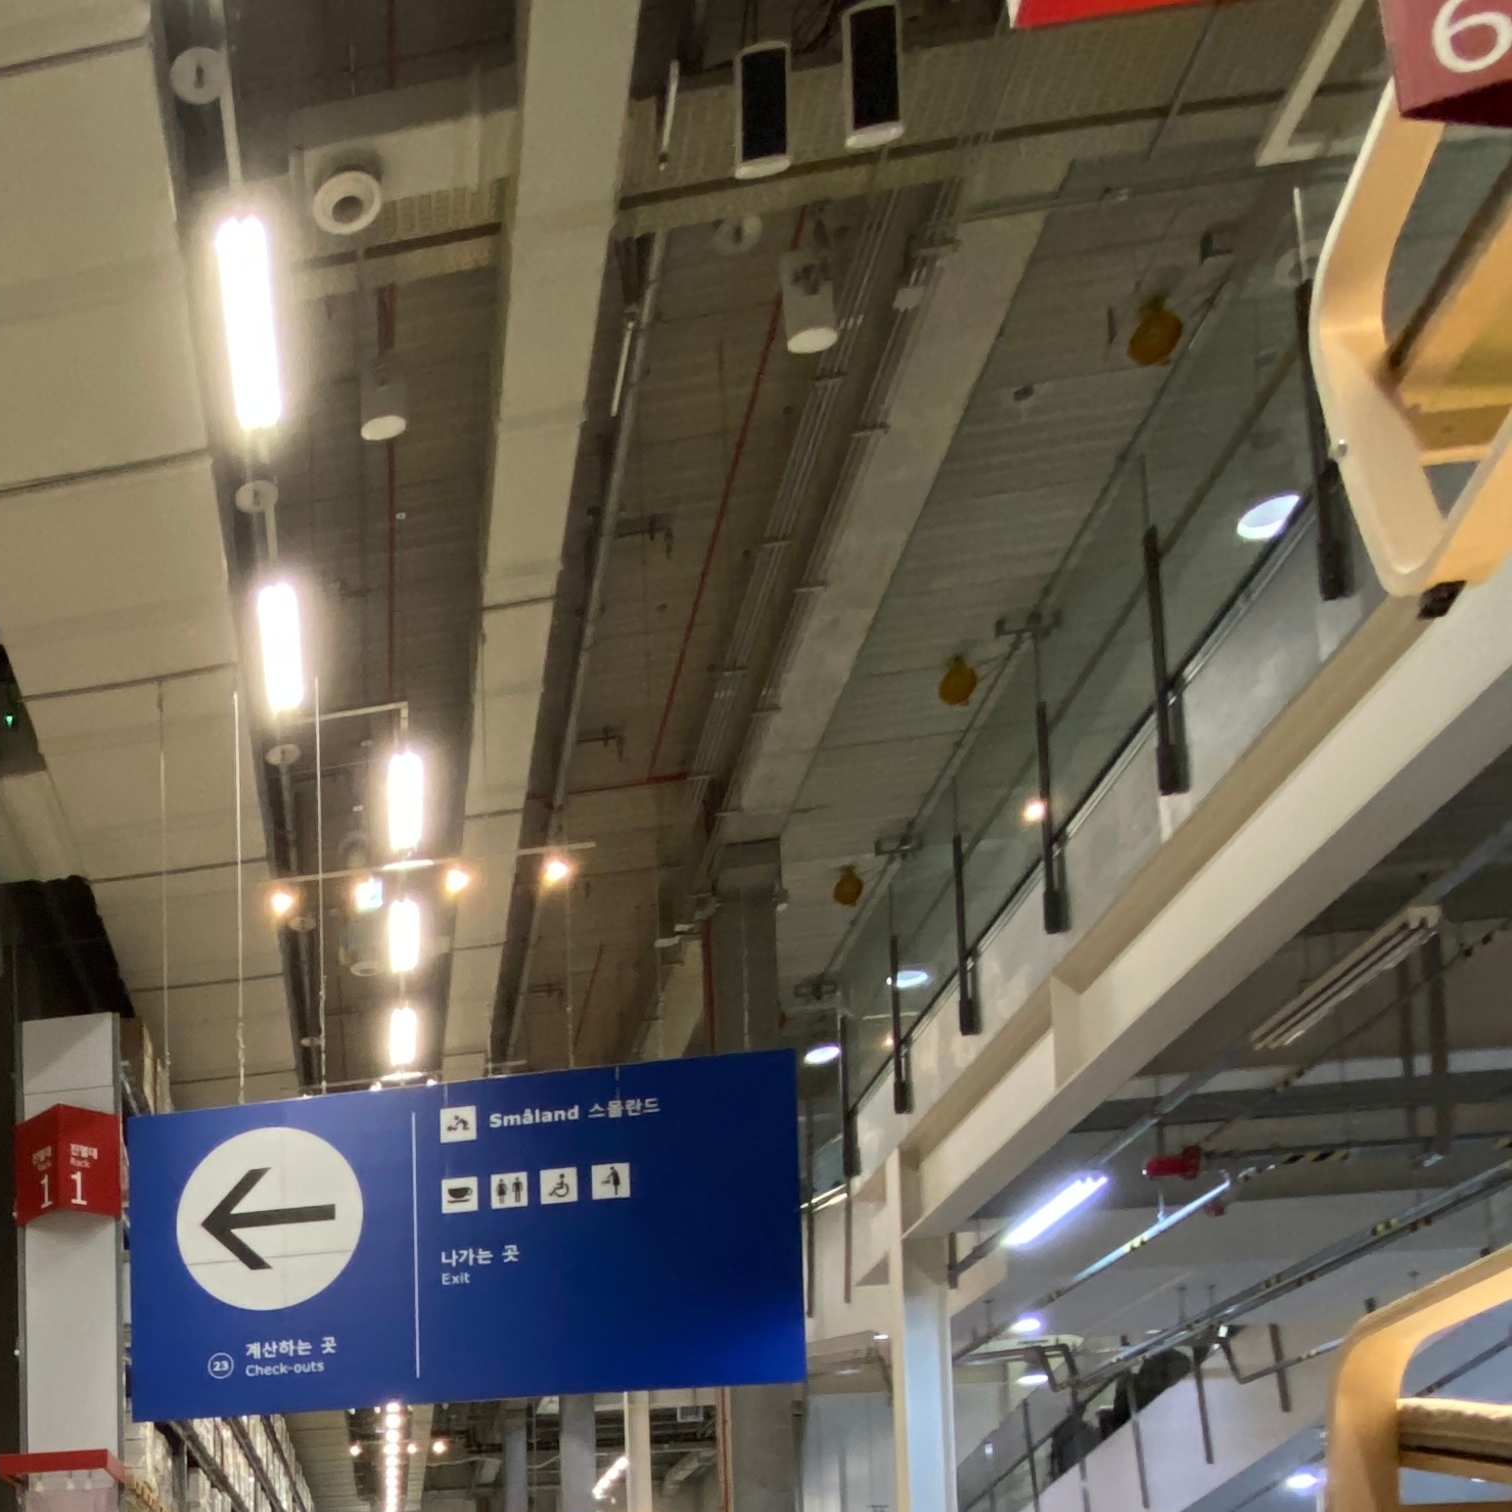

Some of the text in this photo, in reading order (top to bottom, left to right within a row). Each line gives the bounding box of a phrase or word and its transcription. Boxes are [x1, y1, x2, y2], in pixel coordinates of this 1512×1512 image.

[1431, 0, 1512, 74] 6
[489, 1097, 661, 1128] Småland 스몰란드
[40, 1173, 54, 1209] 1
[70, 1170, 87, 1206] 1
[441, 1244, 520, 1267] 나가는 곳
[441, 1271, 471, 1286] Exit
[245, 1336, 337, 1360] 계산하는 곳
[212, 1361, 229, 1372] 23
[245, 1361, 325, 1377] Check-outs
